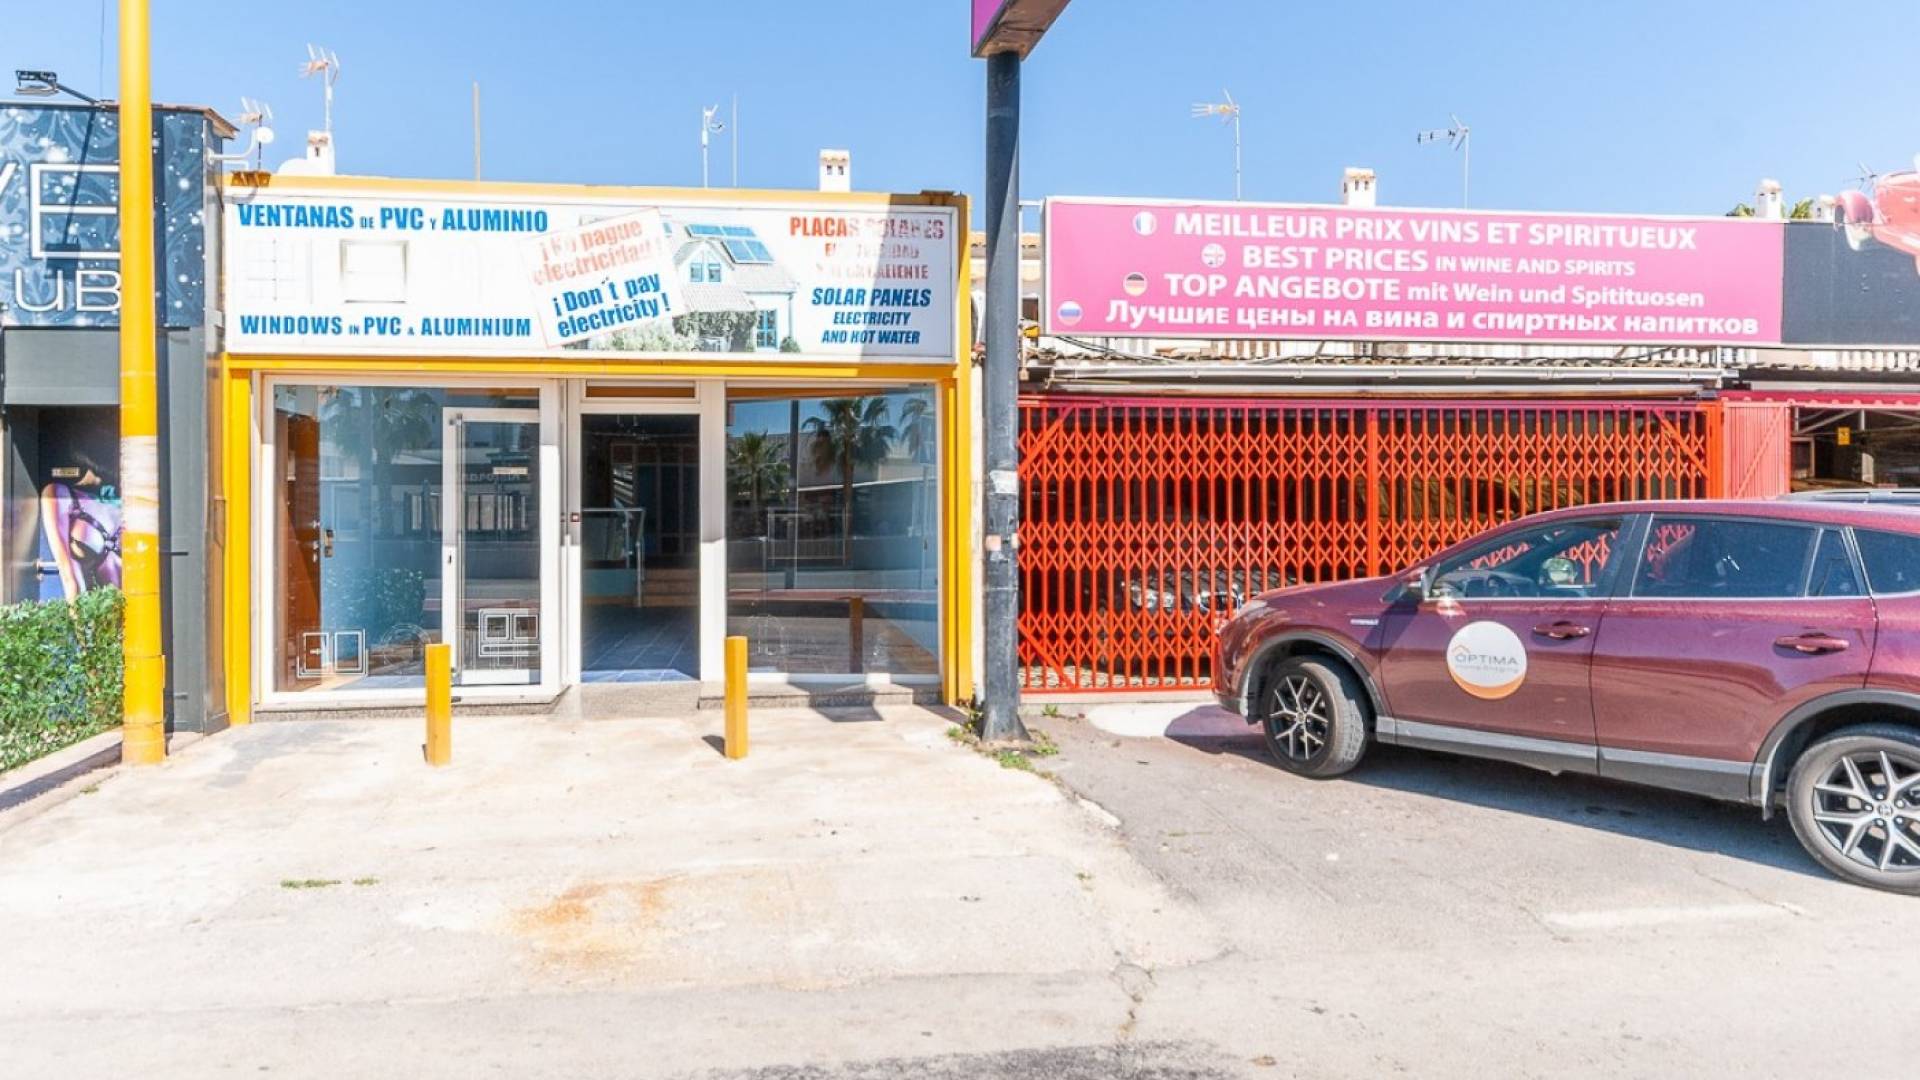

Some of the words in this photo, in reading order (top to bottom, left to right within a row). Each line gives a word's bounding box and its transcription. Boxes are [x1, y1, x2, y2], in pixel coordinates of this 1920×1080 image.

[238, 204, 354, 228] VENTANAS
[360, 216, 374, 229] DE
[380, 207, 424, 230] PVC
[430, 218, 437, 230] Y
[442, 209, 548, 232] ALUMINIO
[581, 219, 642, 251] pague
[1174, 213, 1329, 239] MEILLEUR
[1336, 217, 1403, 241] PRIX
[1409, 219, 1479, 244] VINS
[1487, 222, 1522, 245] ET
[1528, 222, 1697, 250] SPIRITUEUX
[1242, 245, 1319, 269] BEST
[1325, 247, 1429, 272] PRICES
[1436, 258, 1456, 272] IN
[1461, 258, 1512, 274] WINE
[1516, 259, 1560, 275] AND
[1565, 260, 1635, 277] SPIRITS
[624, 273, 661, 299] pay
[812, 288, 866, 306] SOLAR
[870, 288, 931, 307] PANELS
[1163, 273, 1228, 297] TOP
[1234, 275, 1401, 301] ANGEBOTE
[1407, 282, 1448, 301] mit
[1453, 283, 1512, 303] Wein
[1520, 285, 1566, 305] und
[1572, 286, 1704, 308] Spitituosen
[240, 315, 342, 335] WINDOWS
[349, 325, 359, 335] IN
[364, 317, 401, 336] PVC
[421, 318, 531, 337] ALUMINIUM
[833, 311, 911, 326] ELECTRICITY
[1365, 310, 1439, 329] вина
[1447, 311, 1465, 330] и
[1472, 311, 1618, 335] спиртных
[1624, 314, 1759, 335] напитков
[822, 330, 847, 344] AND
[850, 330, 876, 344] HOT
[878, 330, 921, 344] WATER
